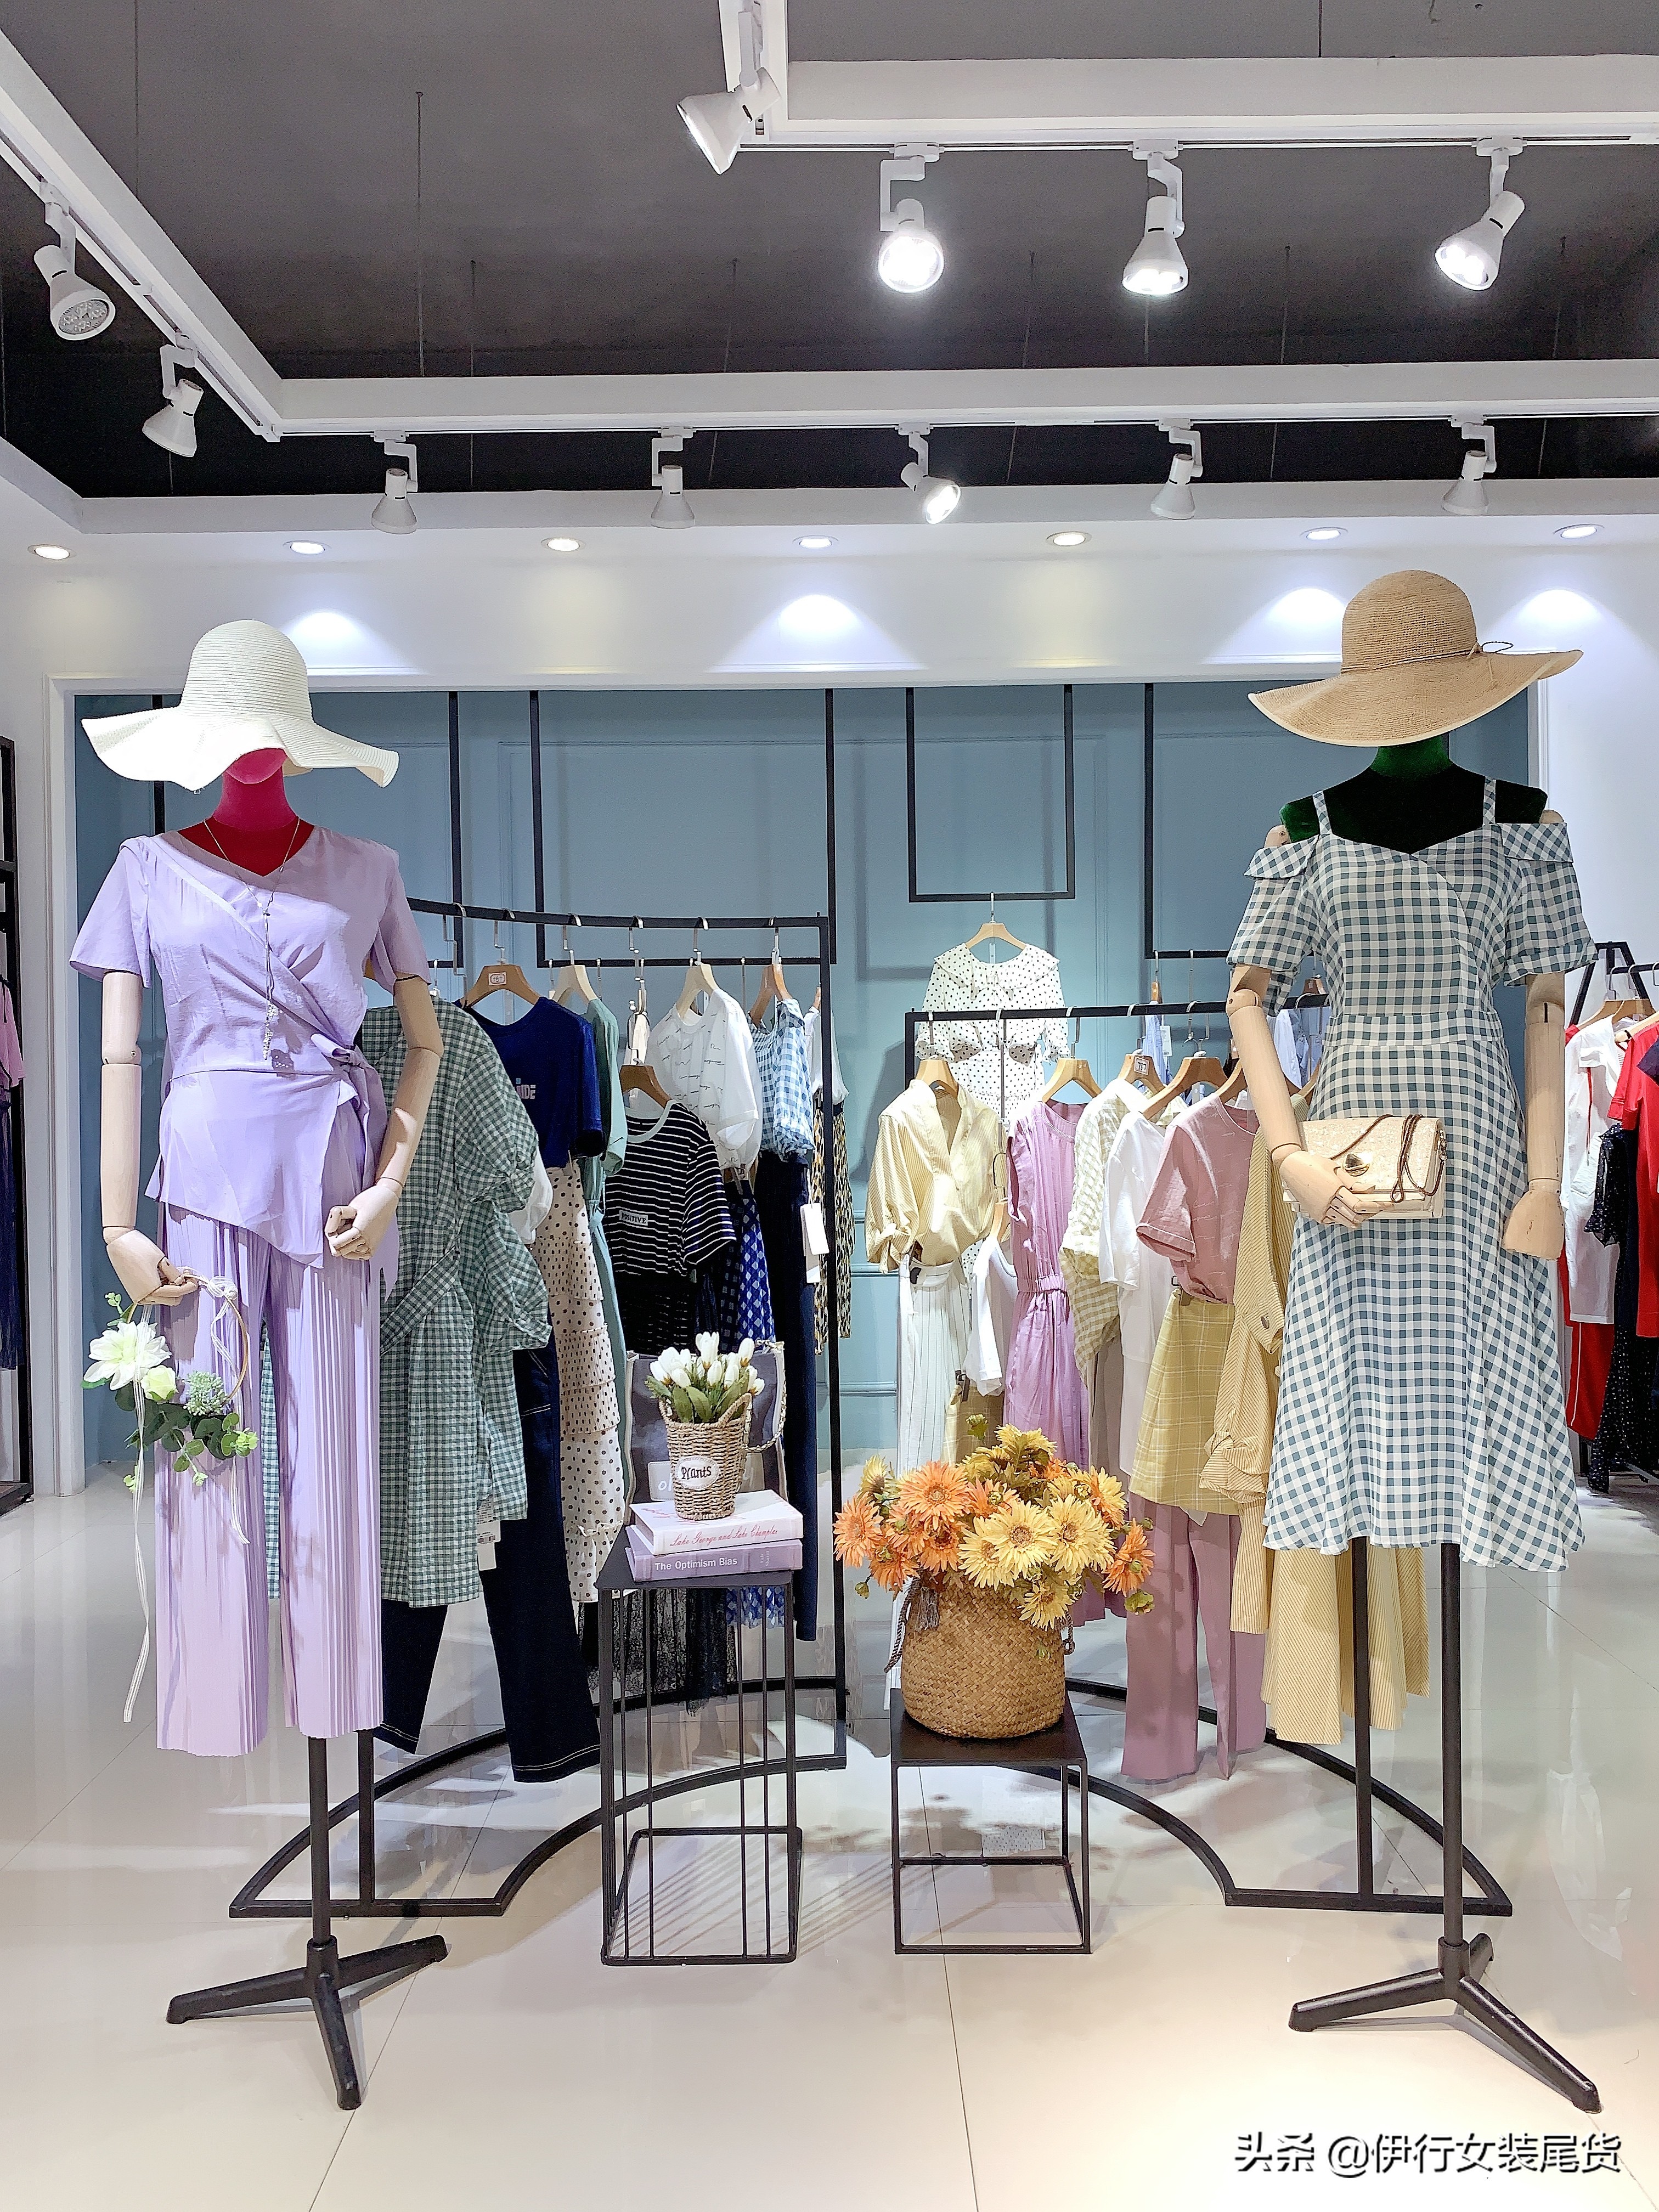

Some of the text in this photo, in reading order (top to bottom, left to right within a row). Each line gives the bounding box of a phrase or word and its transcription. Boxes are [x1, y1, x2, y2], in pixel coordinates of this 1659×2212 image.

[681, 1466, 712, 1480] Plants
[669, 1533, 690, 1546] Lake
[691, 1531, 718, 1546] George
[718, 1528, 734, 1541] and
[732, 1525, 748, 1539] Lake
[654, 1556, 738, 1571] The Optimism Bias
